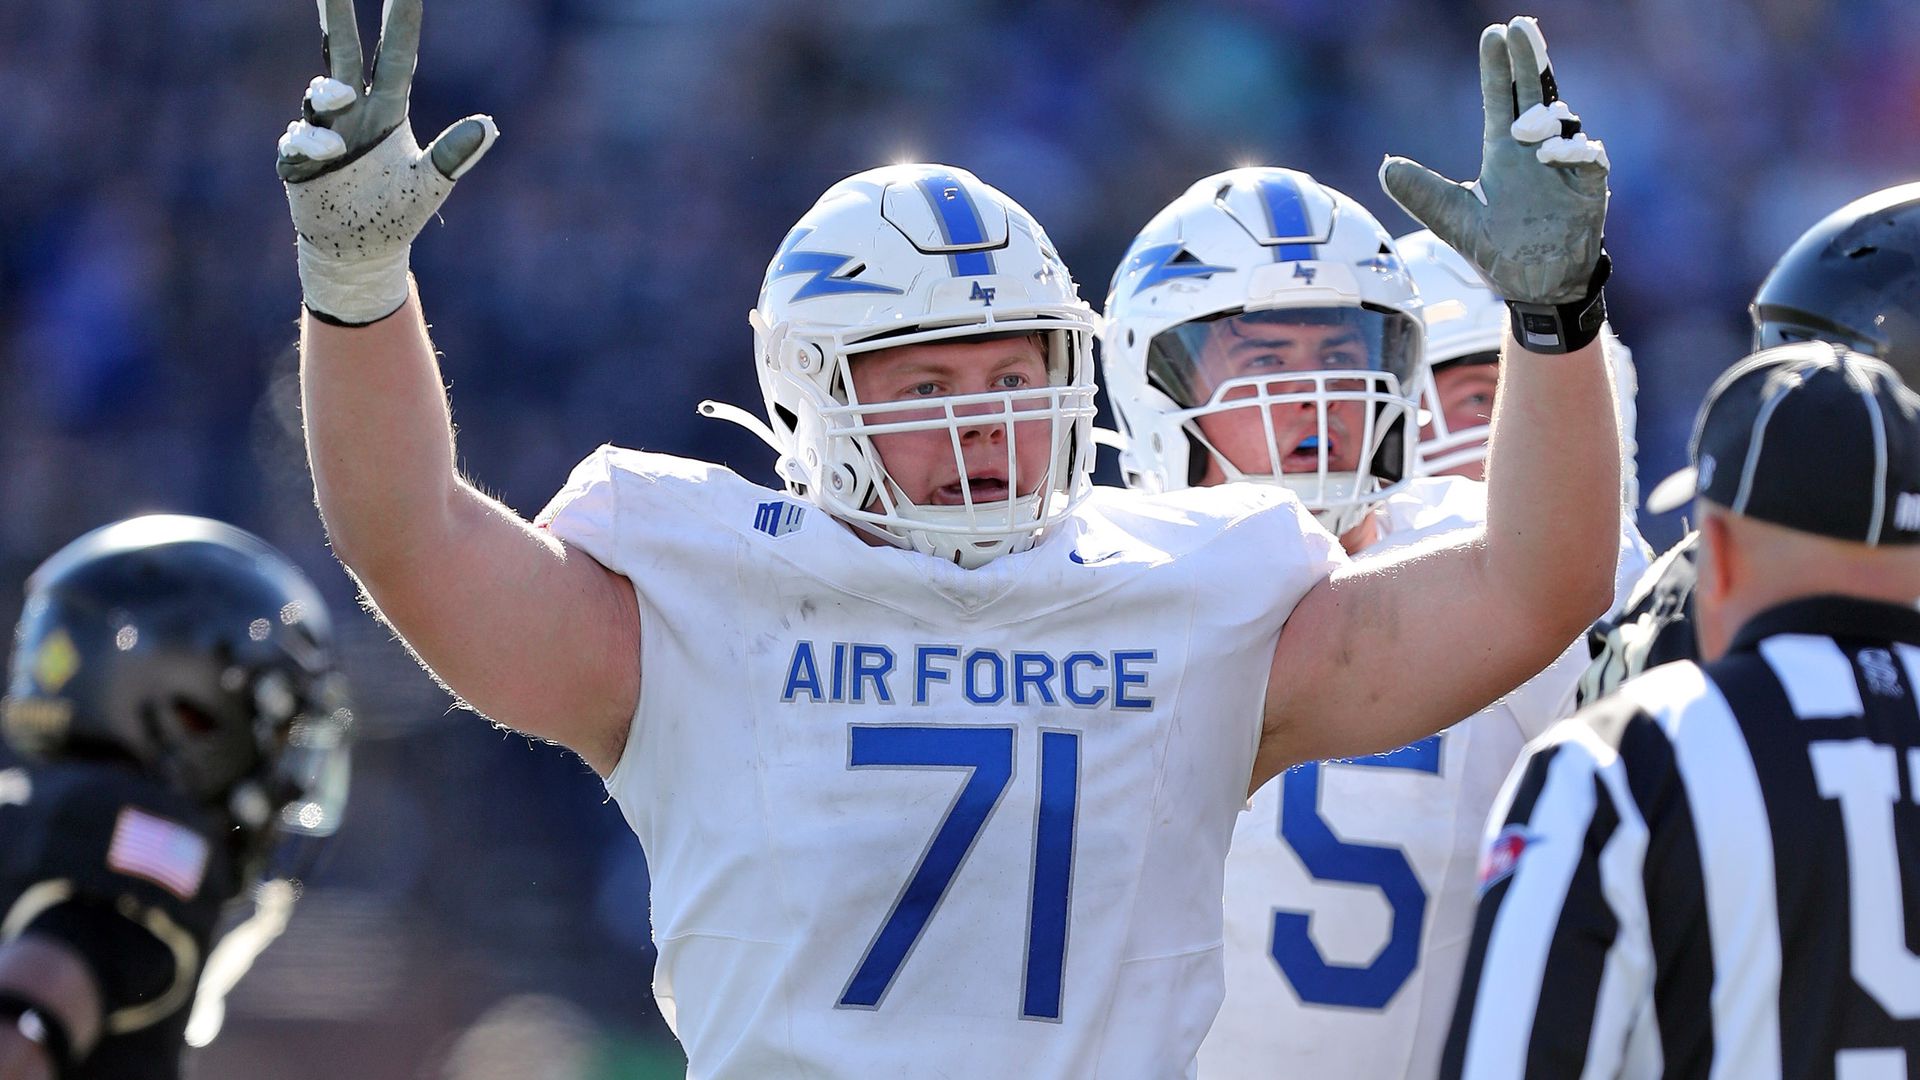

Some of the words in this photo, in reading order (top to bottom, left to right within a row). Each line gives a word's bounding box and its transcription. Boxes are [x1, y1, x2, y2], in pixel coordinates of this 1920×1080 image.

[780, 640, 897, 705] AIR
[912, 644, 1158, 712] FORCE
[832, 722, 1084, 1024] 71
